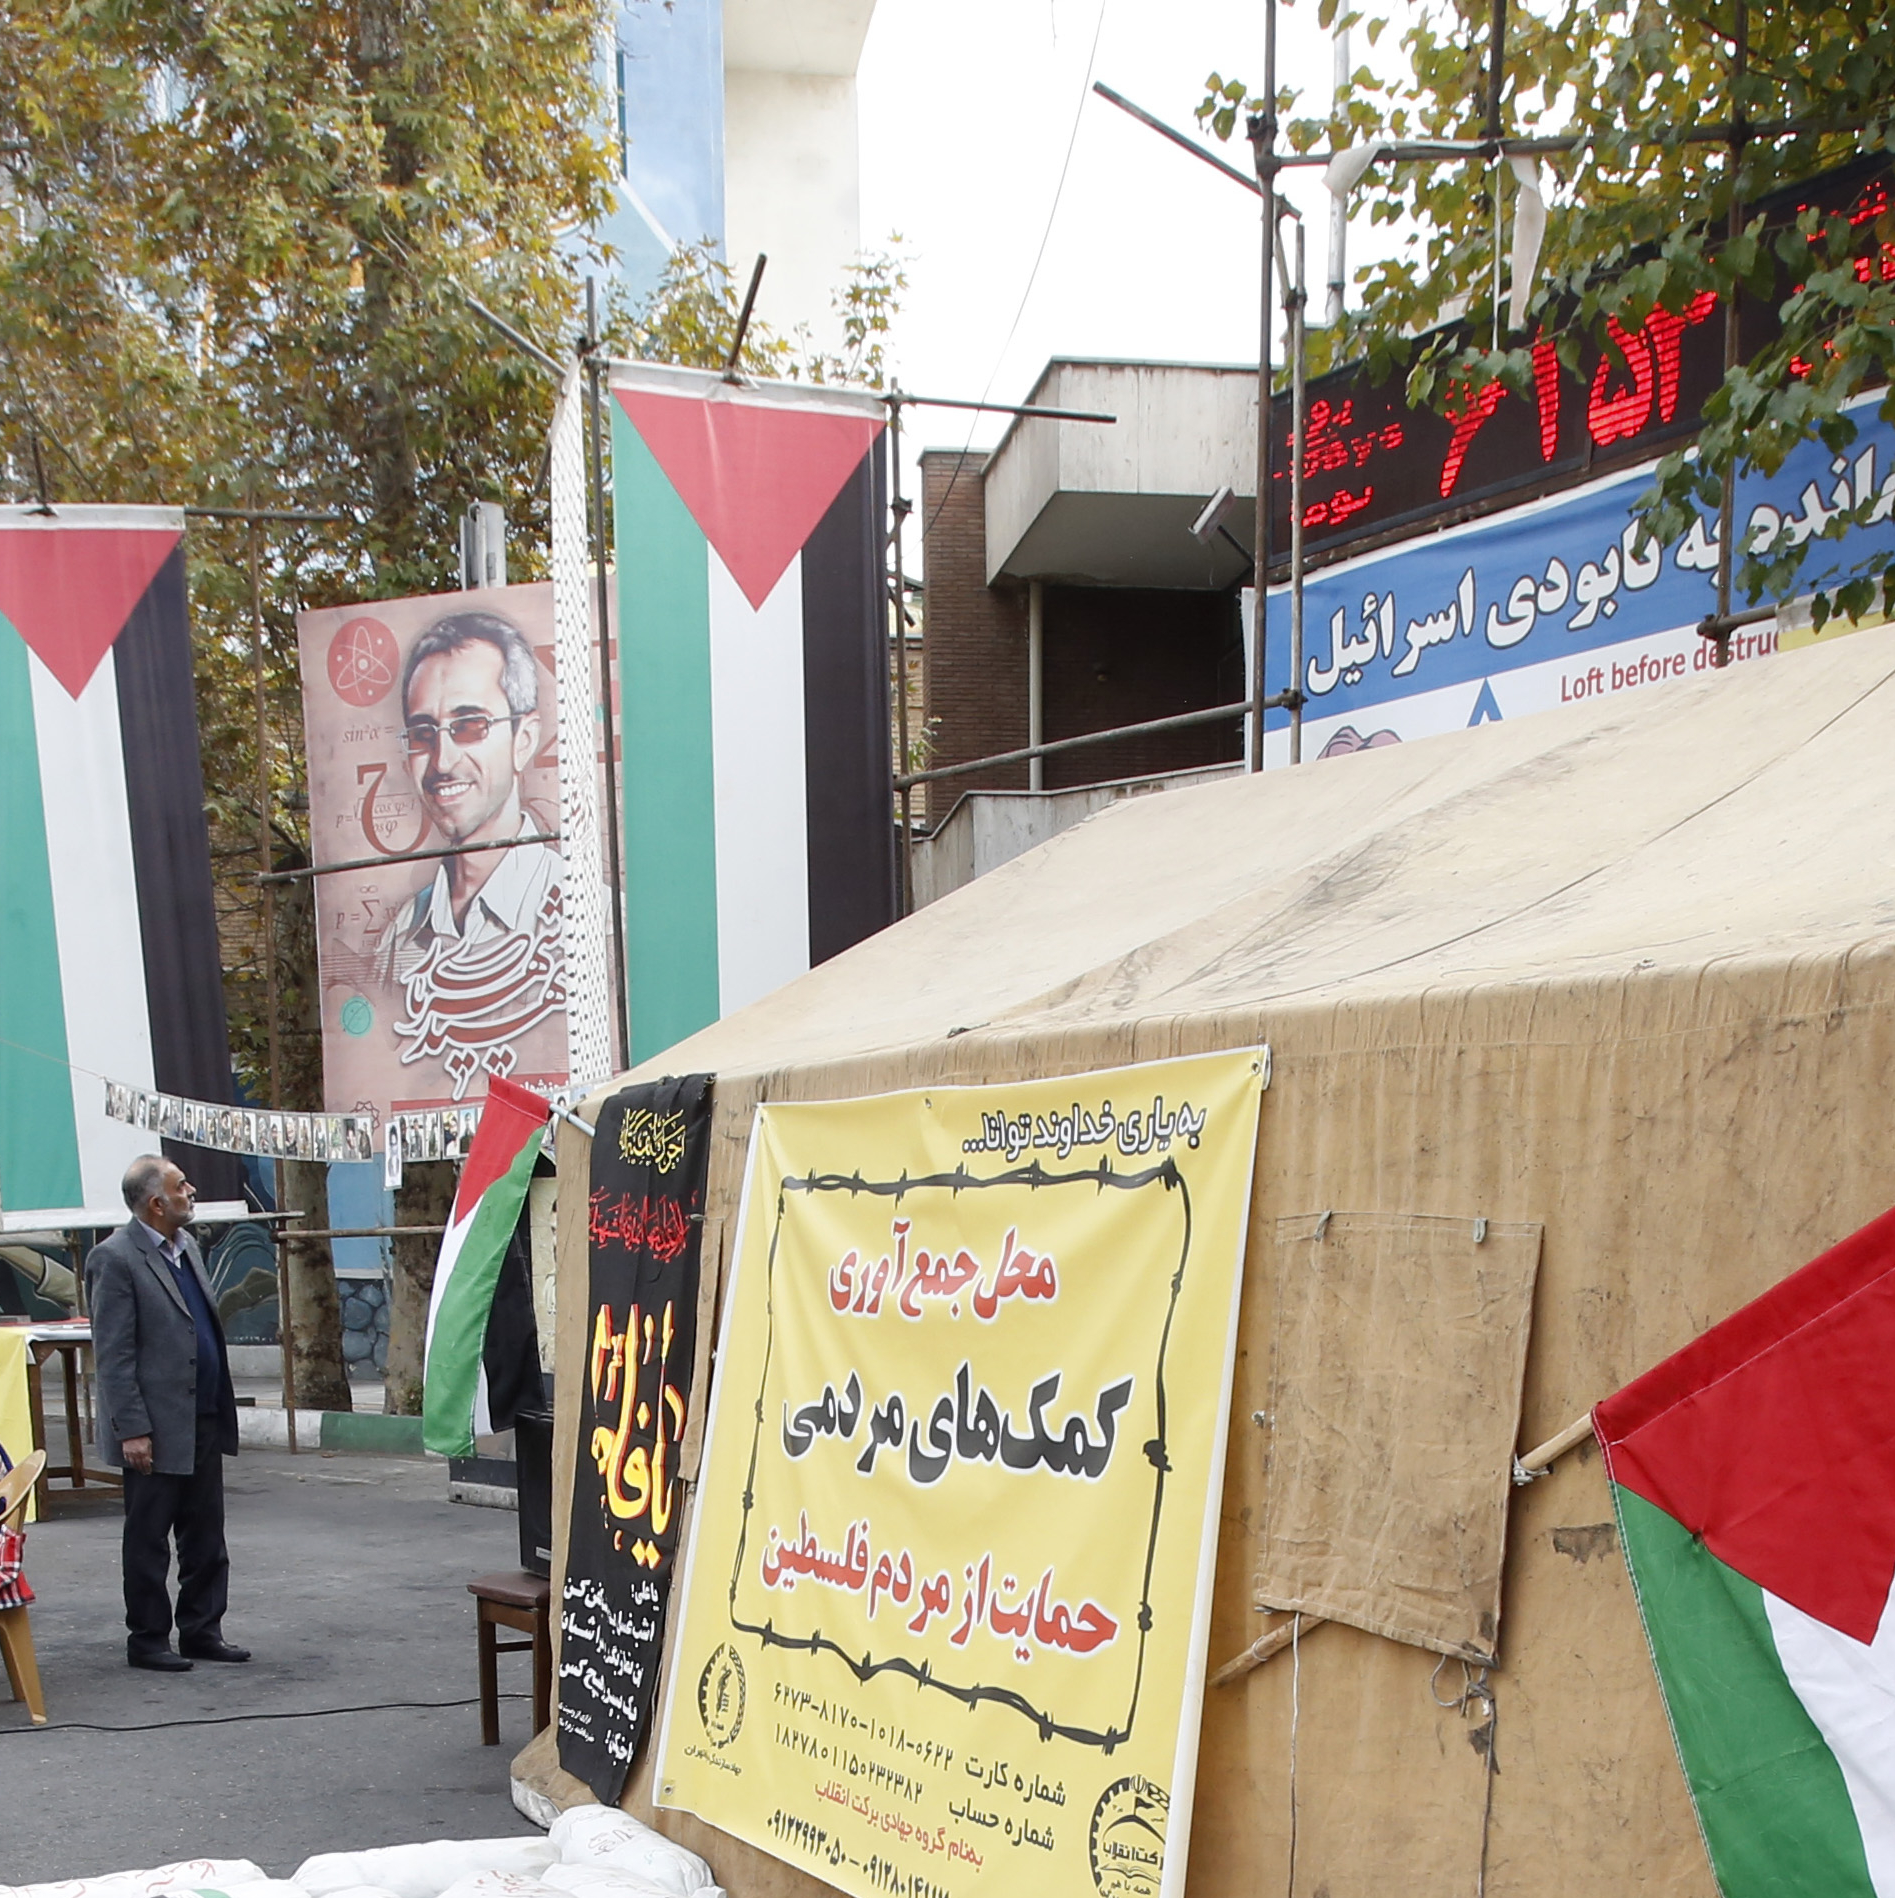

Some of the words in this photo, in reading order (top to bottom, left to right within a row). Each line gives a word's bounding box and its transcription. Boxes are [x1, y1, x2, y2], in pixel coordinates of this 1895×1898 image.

[1306, 564, 1477, 697] اسرائیل
[1561, 667, 1604, 702] Loft
[1611, 653, 1685, 691] before
[962, 1110, 1034, 1162] توانا...
[1034, 1100, 1117, 1159] خداوند
[1117, 1096, 1176, 1154] یاری
[1176, 1101, 1207, 1150] به
[830, 1220, 910, 1314] آوری
[900, 1251, 980, 1317] جمع
[973, 1226, 1056, 1319] محل
[783, 1371, 904, 1473] مردمی
[761, 1510, 870, 1590] فلسطین
[869, 1550, 949, 1632] مردم
[951, 1553, 990, 1644] از
[989, 1568, 1118, 1660] حمایت
[814, 1780, 850, 1808] انقلاب
[965, 1756, 1008, 1789] کارت
[1012, 1768, 1067, 1807] شماره
[850, 1795, 880, 1828] برکت
[879, 1808, 914, 1842] جهادی
[948, 1800, 999, 1829] حساب
[1004, 1815, 1055, 1851] شماره
[913, 1824, 947, 1856] گروه
